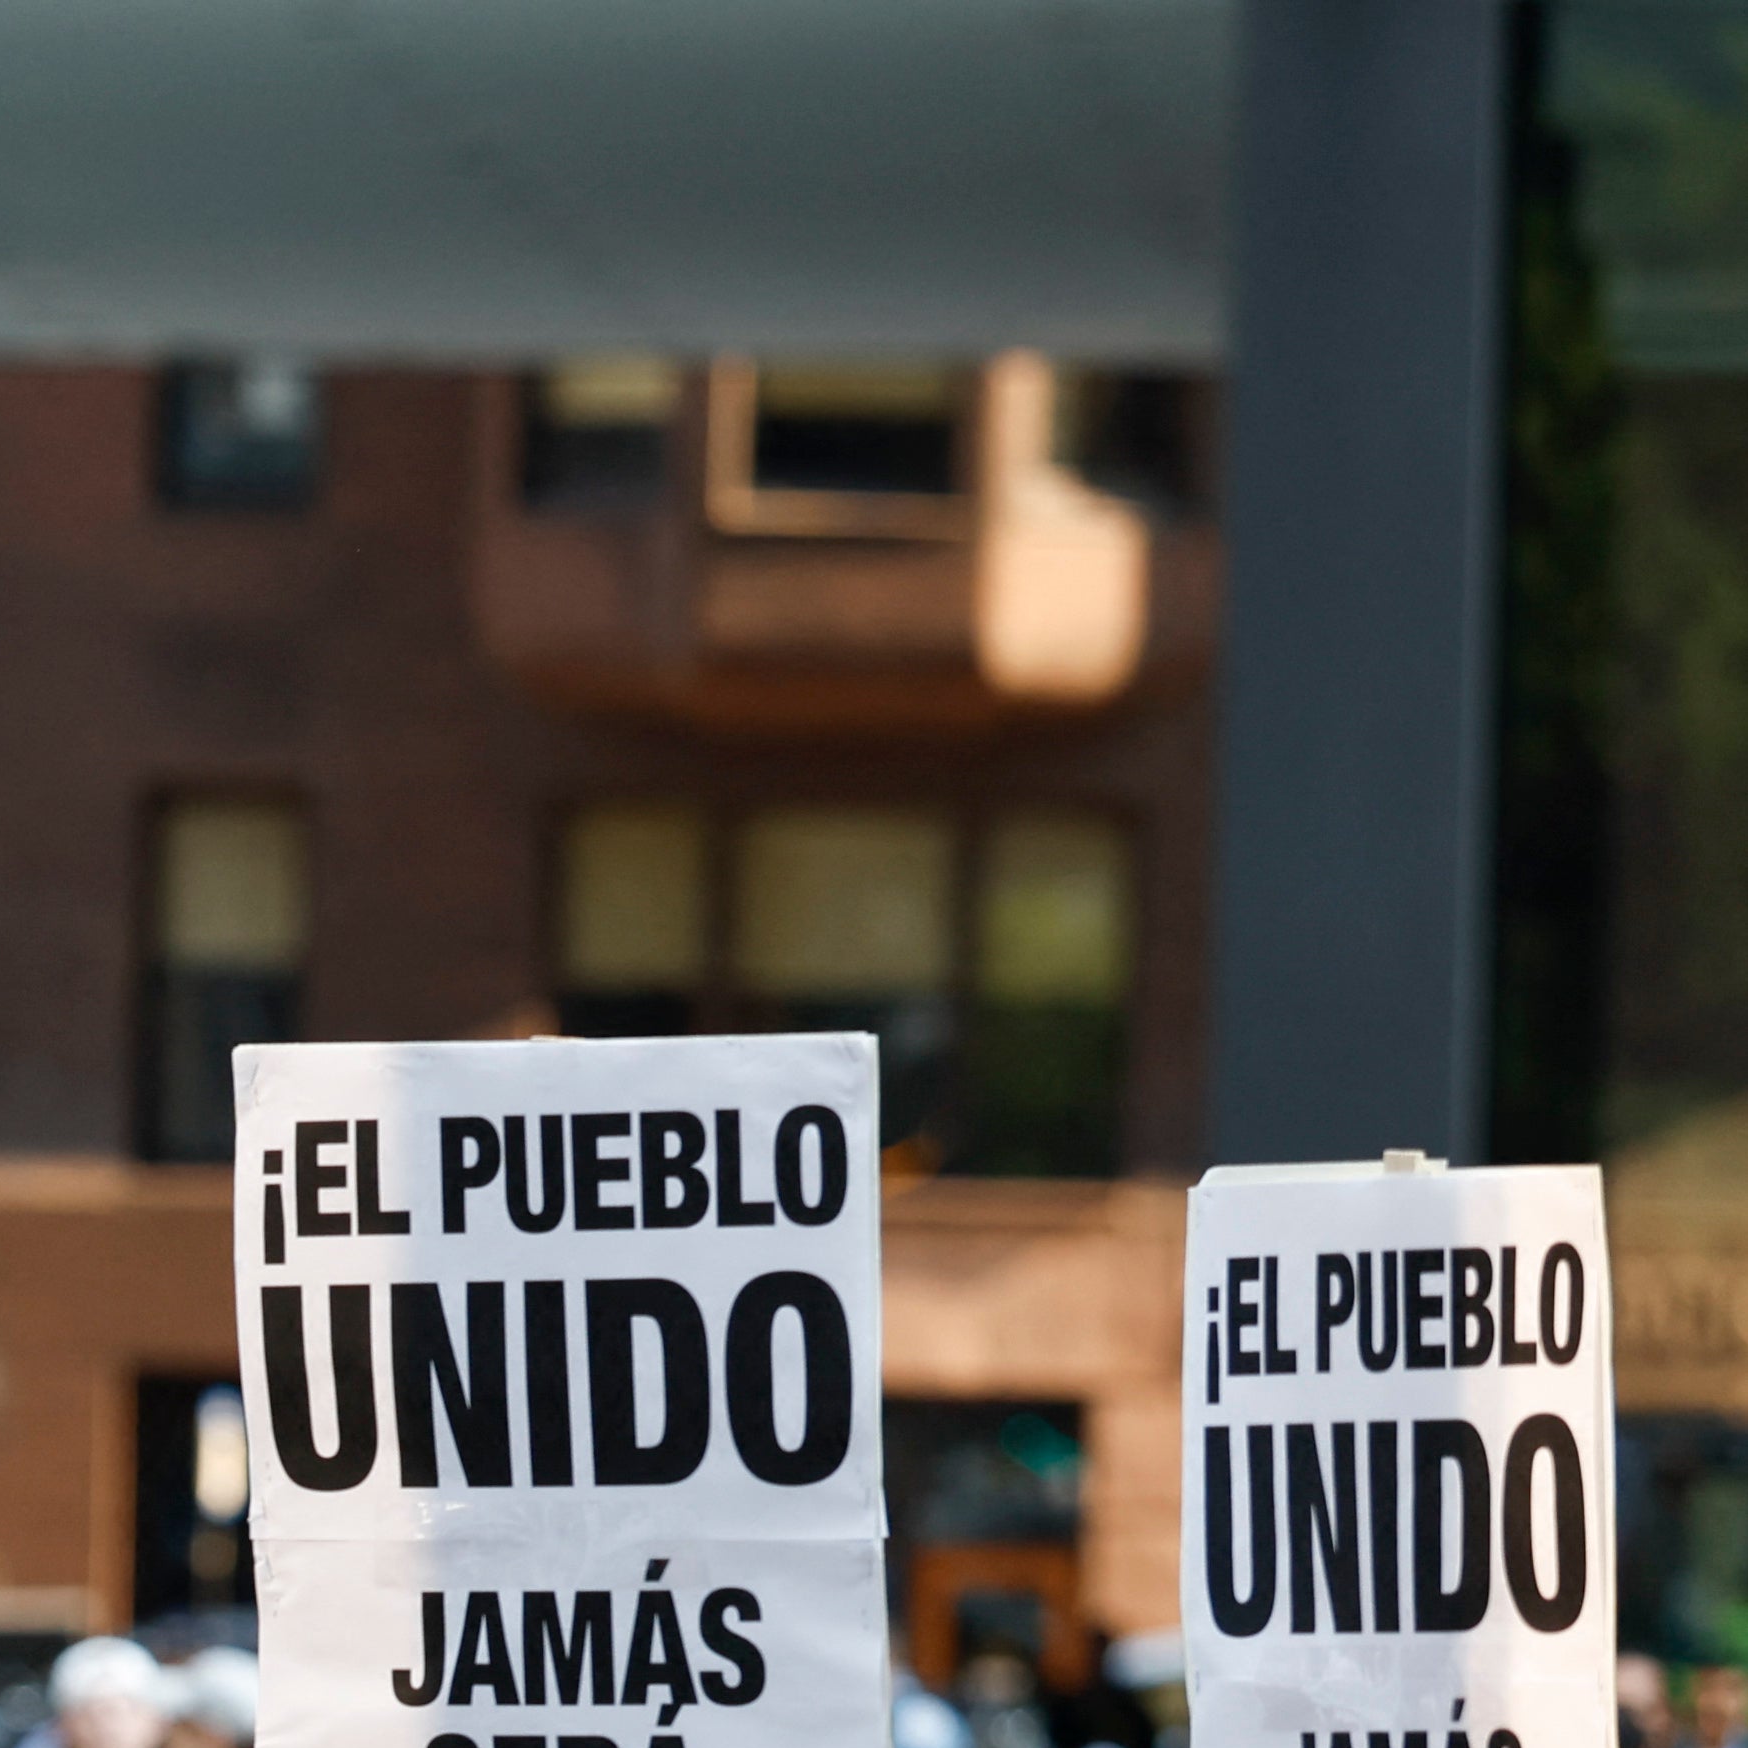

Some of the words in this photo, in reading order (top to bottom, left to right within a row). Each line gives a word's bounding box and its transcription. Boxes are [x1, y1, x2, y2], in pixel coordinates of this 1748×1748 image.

[262, 1119, 412, 1265] ¡EL
[439, 1103, 849, 1235] PUEBLO
[260, 1269, 853, 1492] UNIDO
[1207, 1255, 1298, 1405] ¡EL
[1316, 1242, 1585, 1373] PUEBLO
[1204, 1413, 1588, 1638] UNIDO
[391, 1557, 767, 1709] JAMÁS
